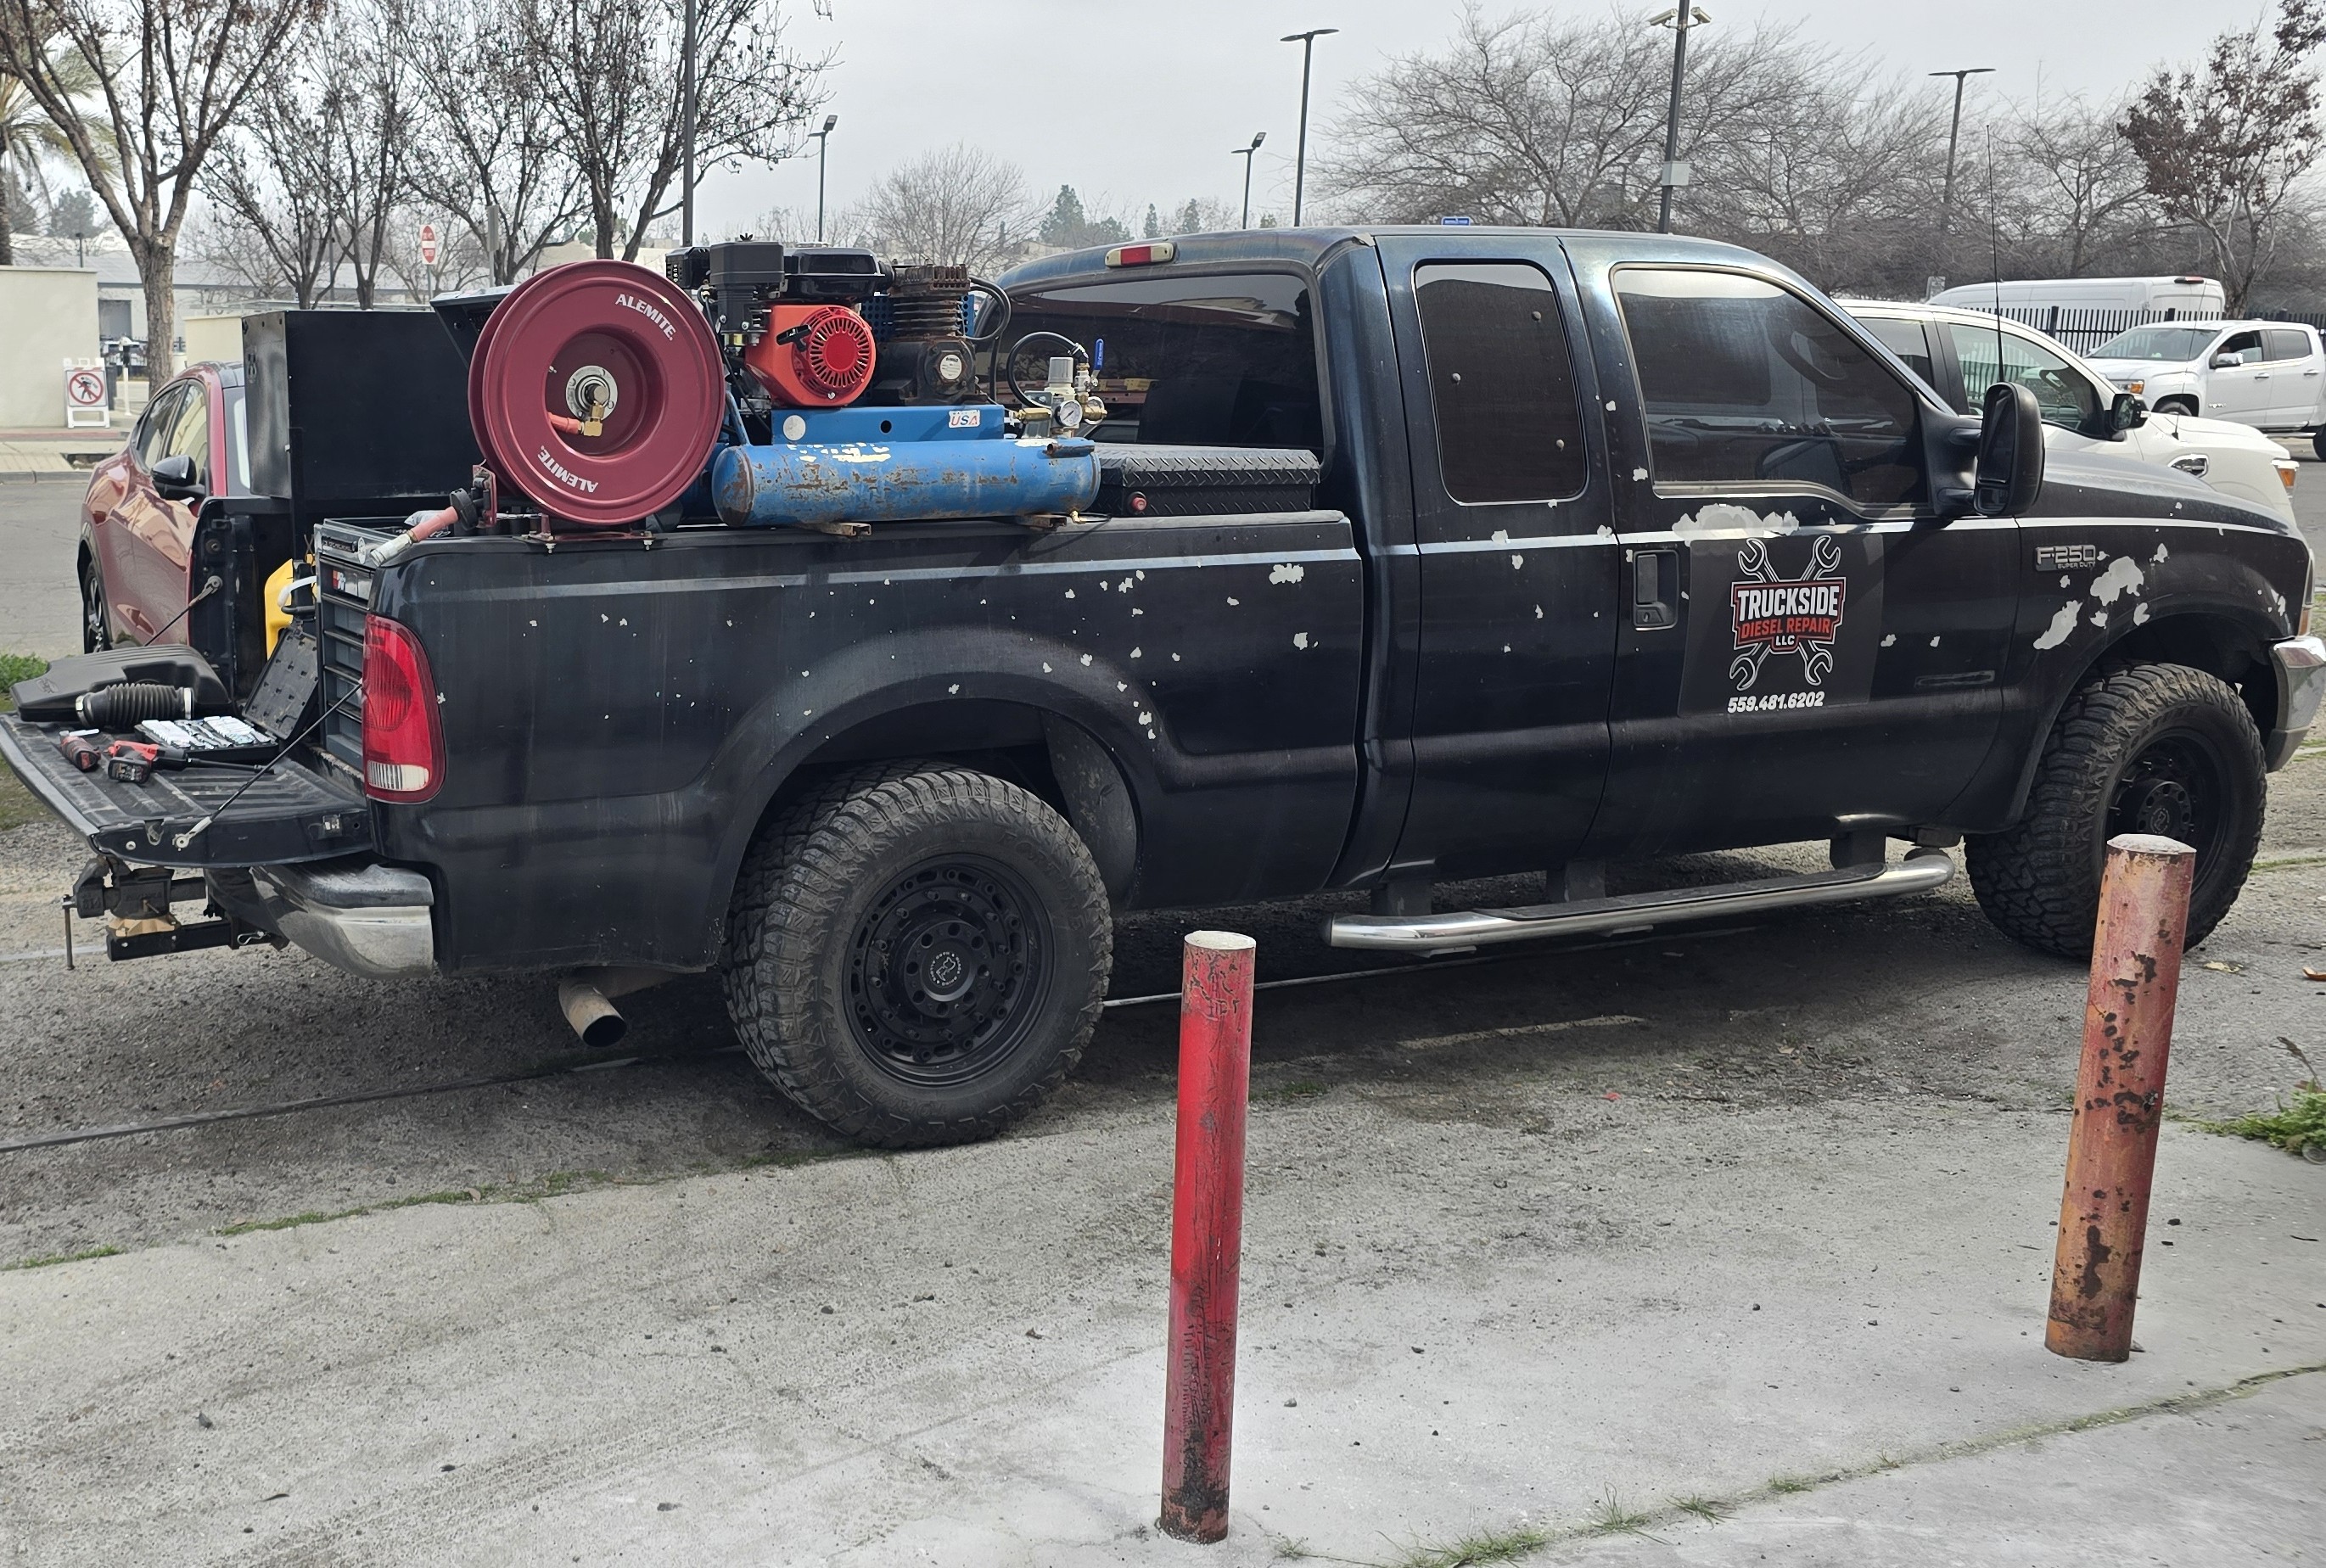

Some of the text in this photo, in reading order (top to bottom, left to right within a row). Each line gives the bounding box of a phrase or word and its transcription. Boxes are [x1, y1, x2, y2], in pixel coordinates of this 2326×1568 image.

[615, 294, 676, 339] ALEMITE
[950, 415, 978, 426] USA
[537, 447, 599, 493] ALEMITE
[1738, 585, 1840, 622] TRUCKSIDE
[1741, 617, 1831, 639] DIESEL REPAIR
[1775, 635, 1796, 646] LLC
[1727, 691, 1825, 714] 559.481.6202
